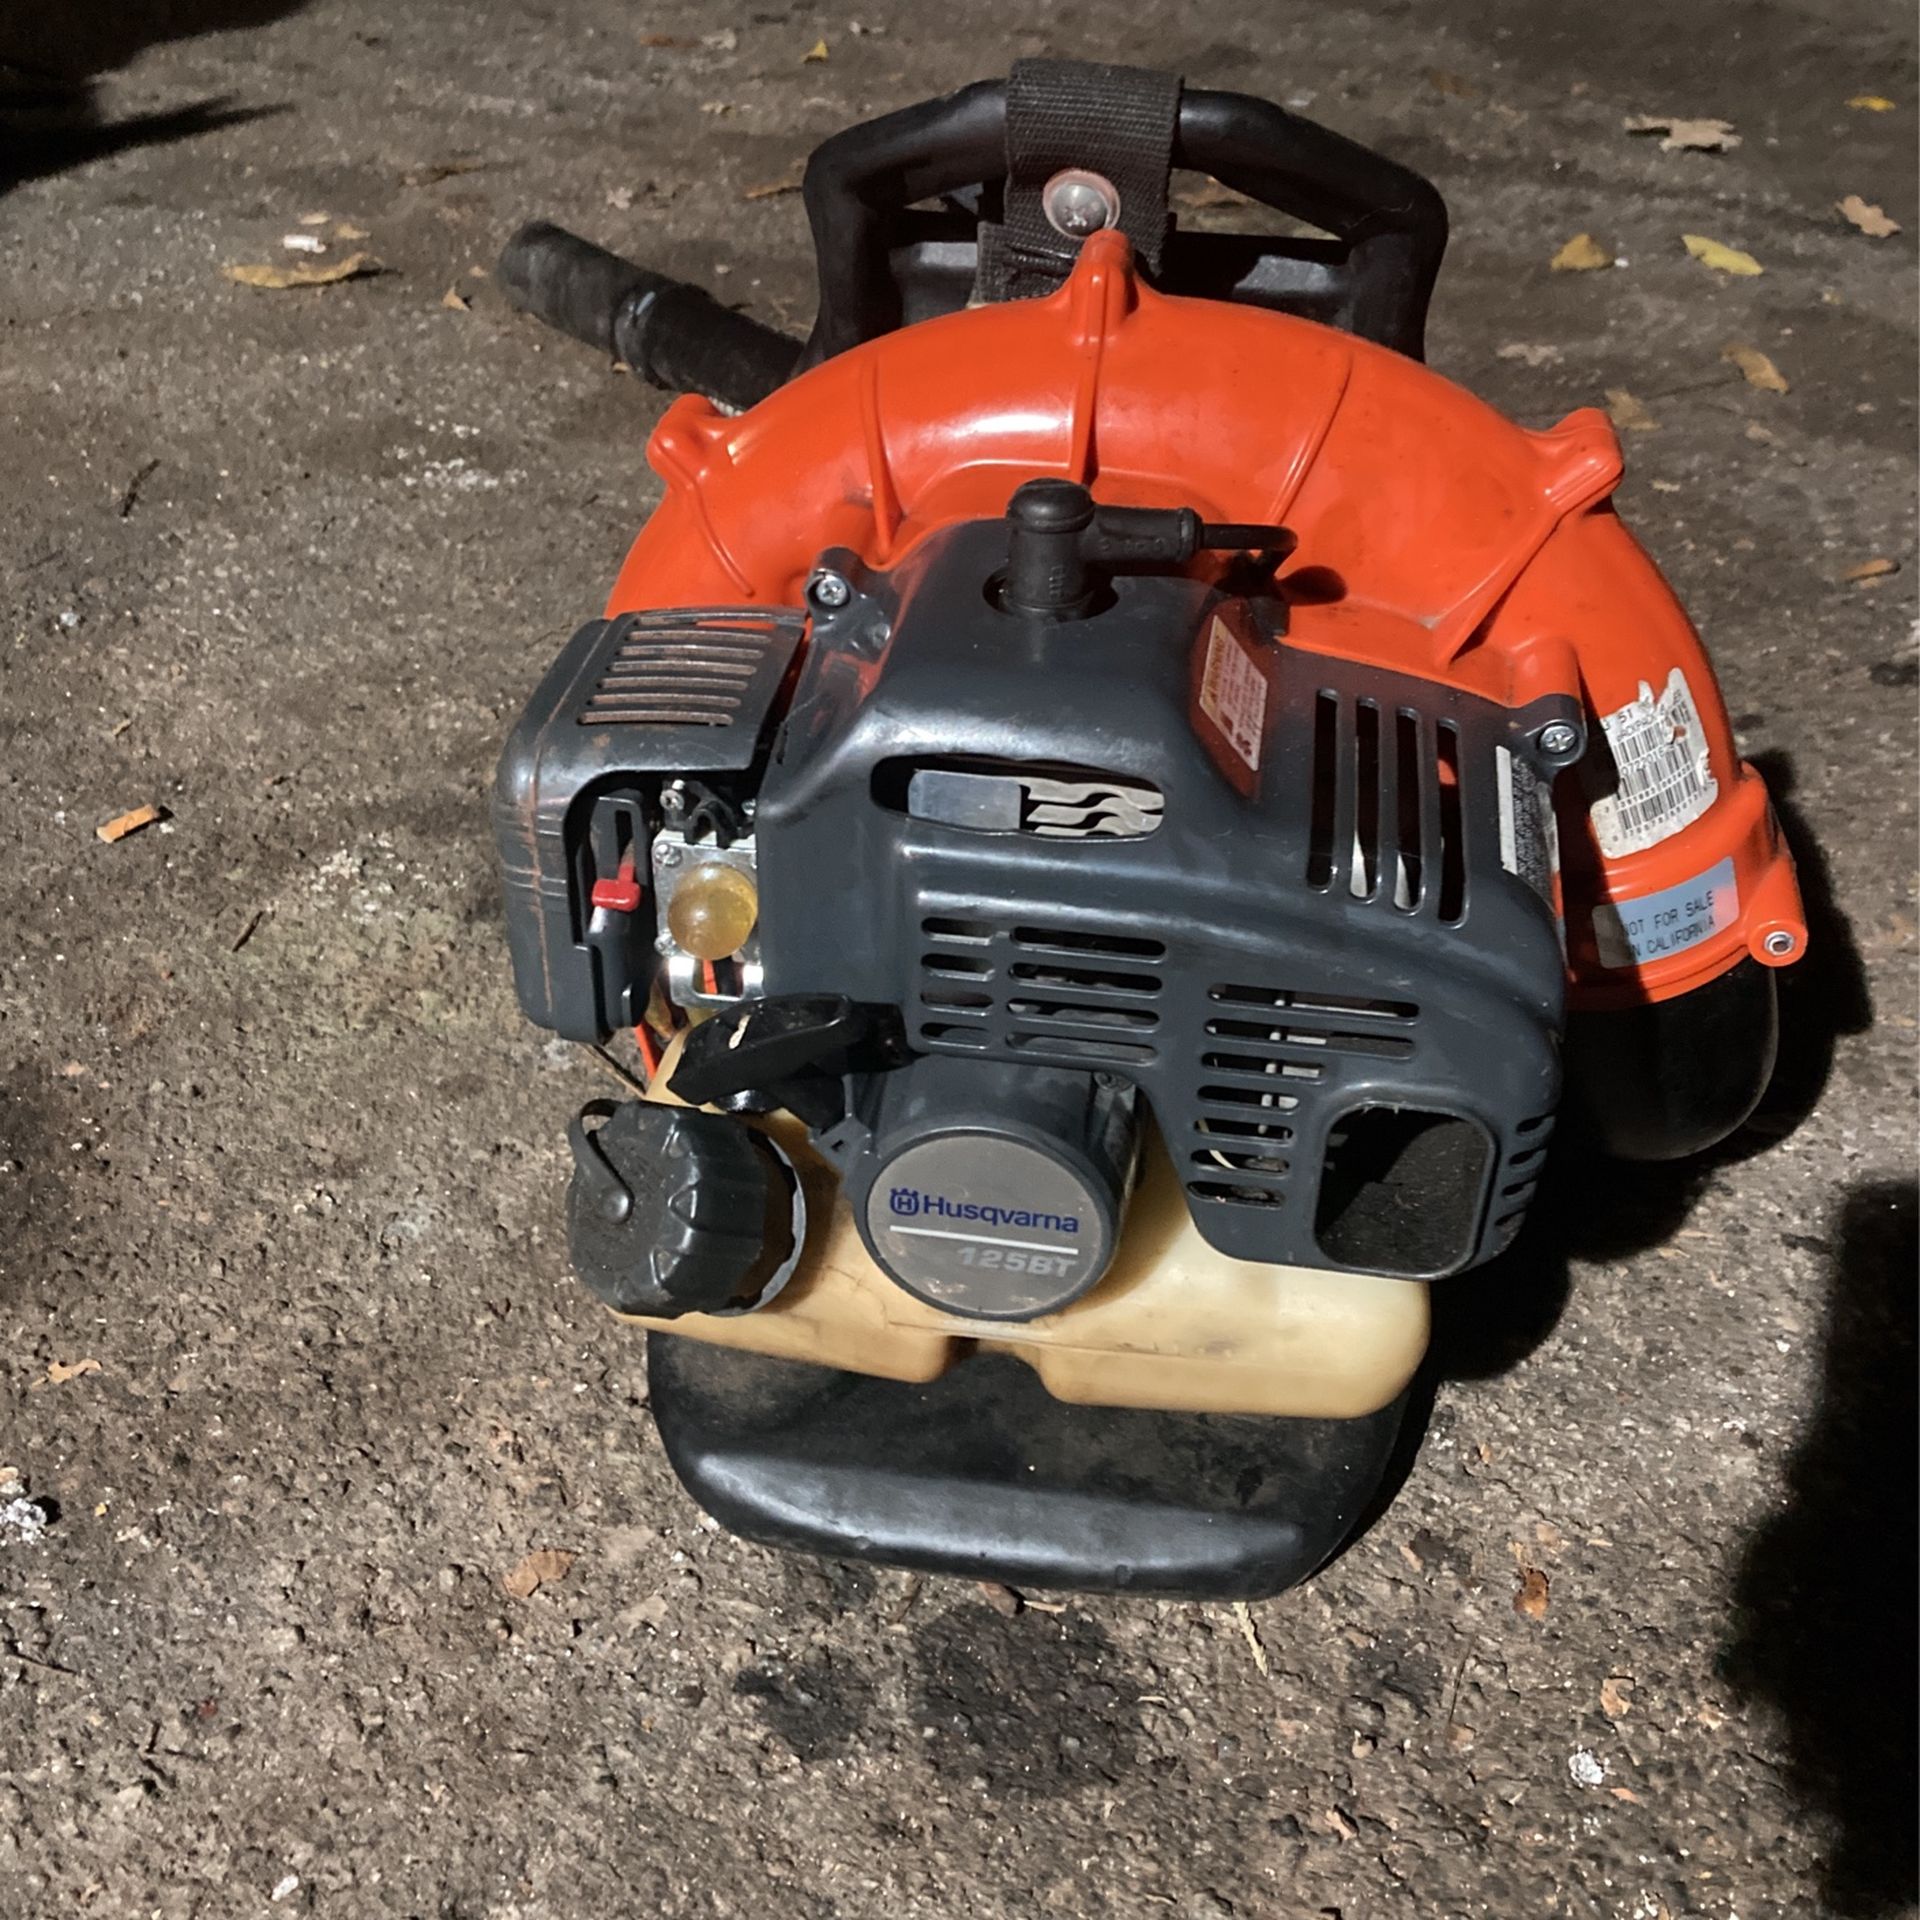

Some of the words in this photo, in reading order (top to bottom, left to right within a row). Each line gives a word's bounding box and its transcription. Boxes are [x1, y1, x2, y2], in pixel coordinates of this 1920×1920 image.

[1653, 908, 1679, 930] FOR
[1685, 890, 1714, 918] SALE
[1646, 914, 1715, 955] CALIFORNIA
[923, 1194, 1079, 1233] Husqvarna
[956, 1247, 1079, 1278] 125BT
